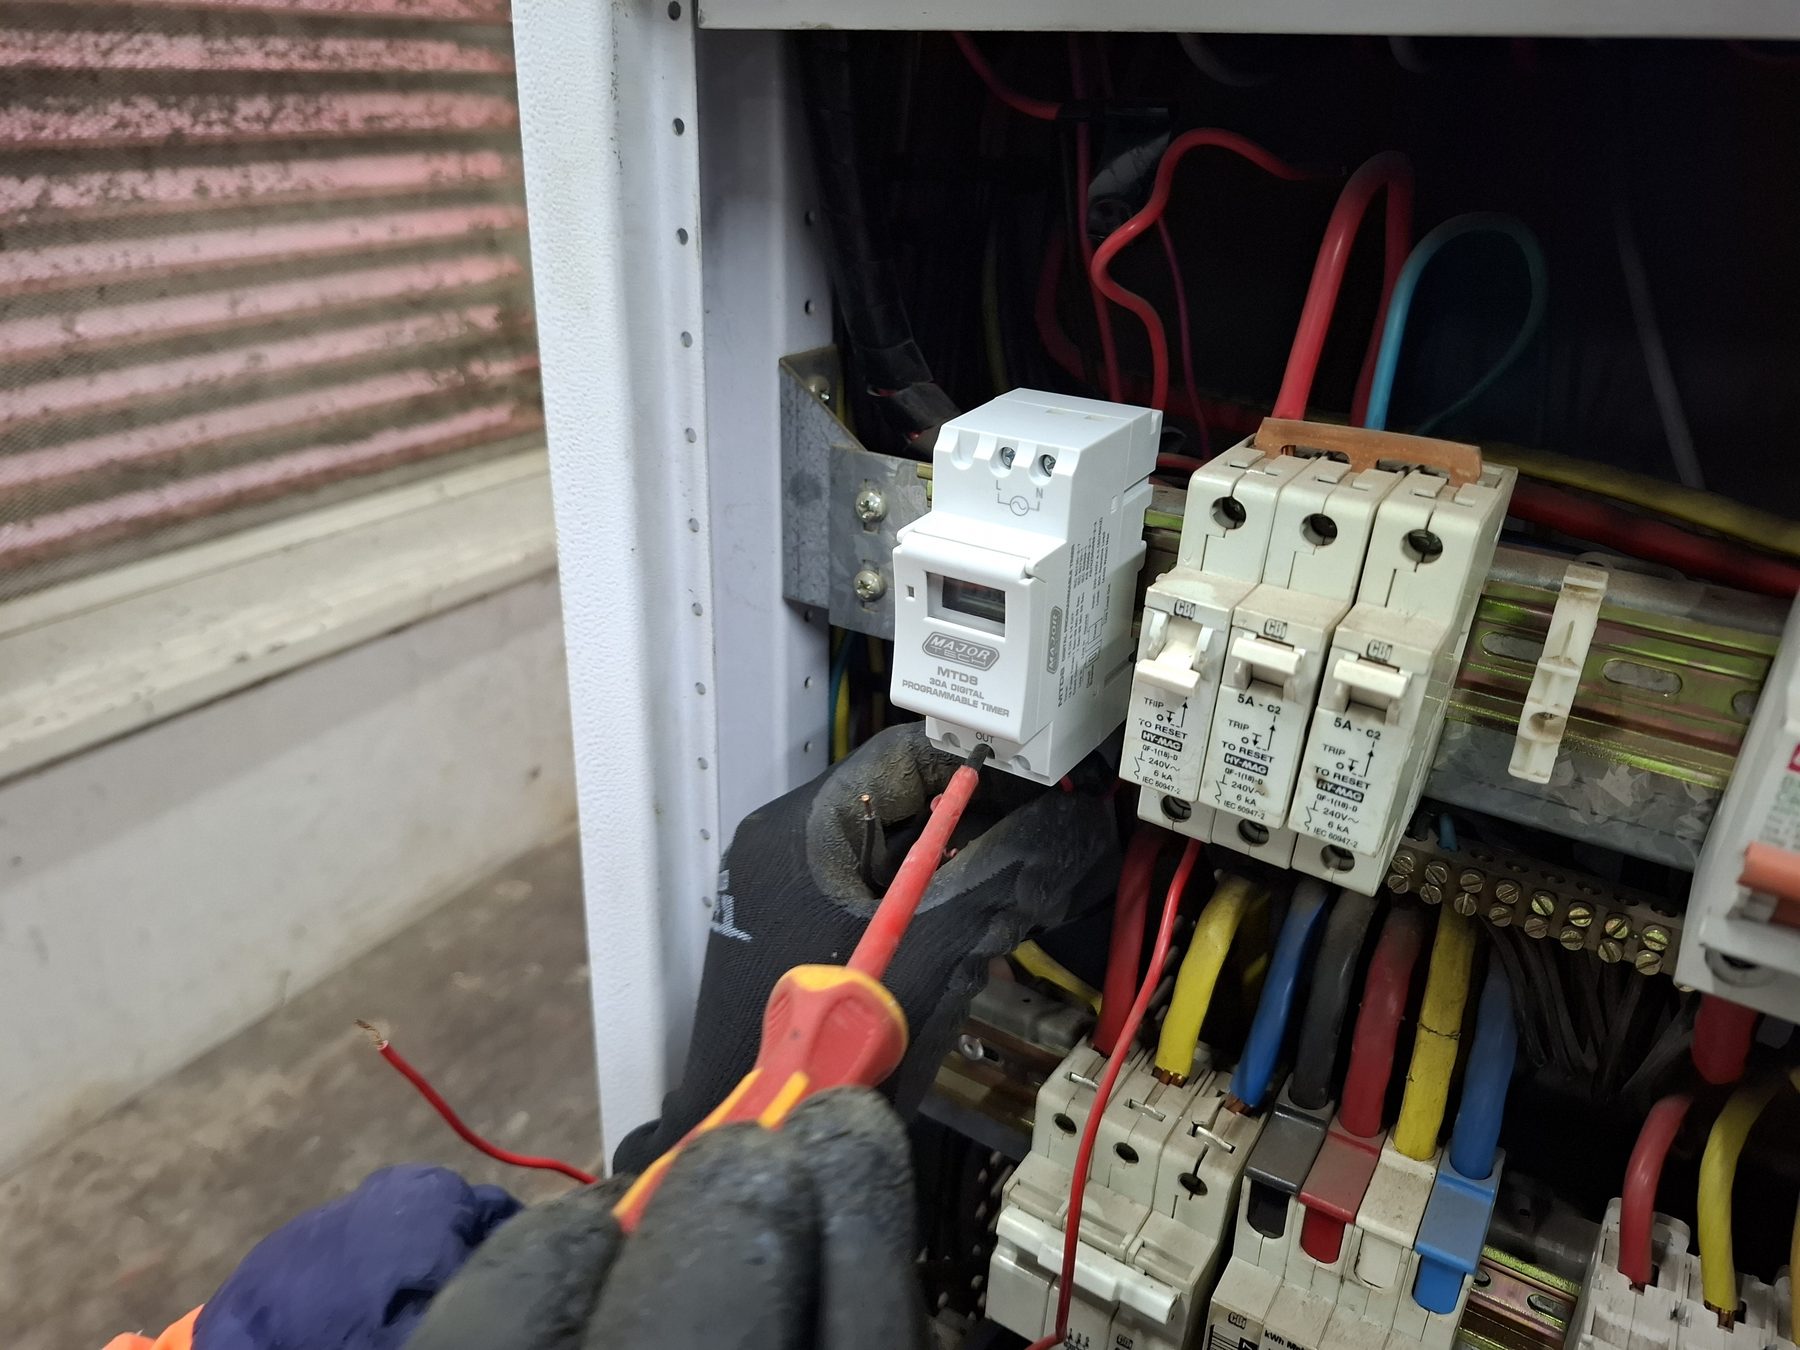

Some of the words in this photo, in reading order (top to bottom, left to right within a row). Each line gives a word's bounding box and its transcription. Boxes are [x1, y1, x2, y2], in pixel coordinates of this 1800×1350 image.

[1036, 488, 1043, 499] N
[930, 636, 991, 660] MAJOR
[1048, 614, 1058, 669] MAJOR
[937, 665, 979, 686] MTD8
[902, 679, 979, 709] PROGRAMMABLE
[981, 702, 1010, 718] TIMER
[929, 677, 948, 689] 30A
[951, 682, 985, 700] DIGITAL
[1144, 697, 1164, 708] TRIP
[1237, 693, 1254, 707] 5A
[1267, 704, 1282, 715] C2
[1139, 718, 1152, 728] TO
[1154, 724, 1188, 740] RESET
[1228, 719, 1250, 731] TRIP
[1334, 717, 1352, 731] 5A
[1366, 729, 1381, 741] C2
[975, 731, 995, 744] OUT
[1142, 731, 1182, 751] HY-MAG
[1222, 740, 1236, 751] TO
[1239, 746, 1275, 763] RESET
[1322, 743, 1346, 756] TRIP
[1225, 754, 1268, 775] HY-MAG
[1142, 776, 1154, 785] IEC
[1155, 780, 1181, 795] 60947-2
[1162, 772, 1173, 782] kA
[1314, 766, 1330, 777] TO
[1333, 771, 1371, 790] RESET
[1317, 779, 1363, 802] HY-MAG
[1224, 800, 1236, 810] IEC
[1237, 805, 1265, 820] 60947-2
[1245, 797, 1257, 806] kA
[1313, 827, 1327, 838] IEC
[1328, 832, 1359, 849] 60947-2
[1336, 823, 1350, 834] kA
[1264, 1330, 1284, 1346] kWh
